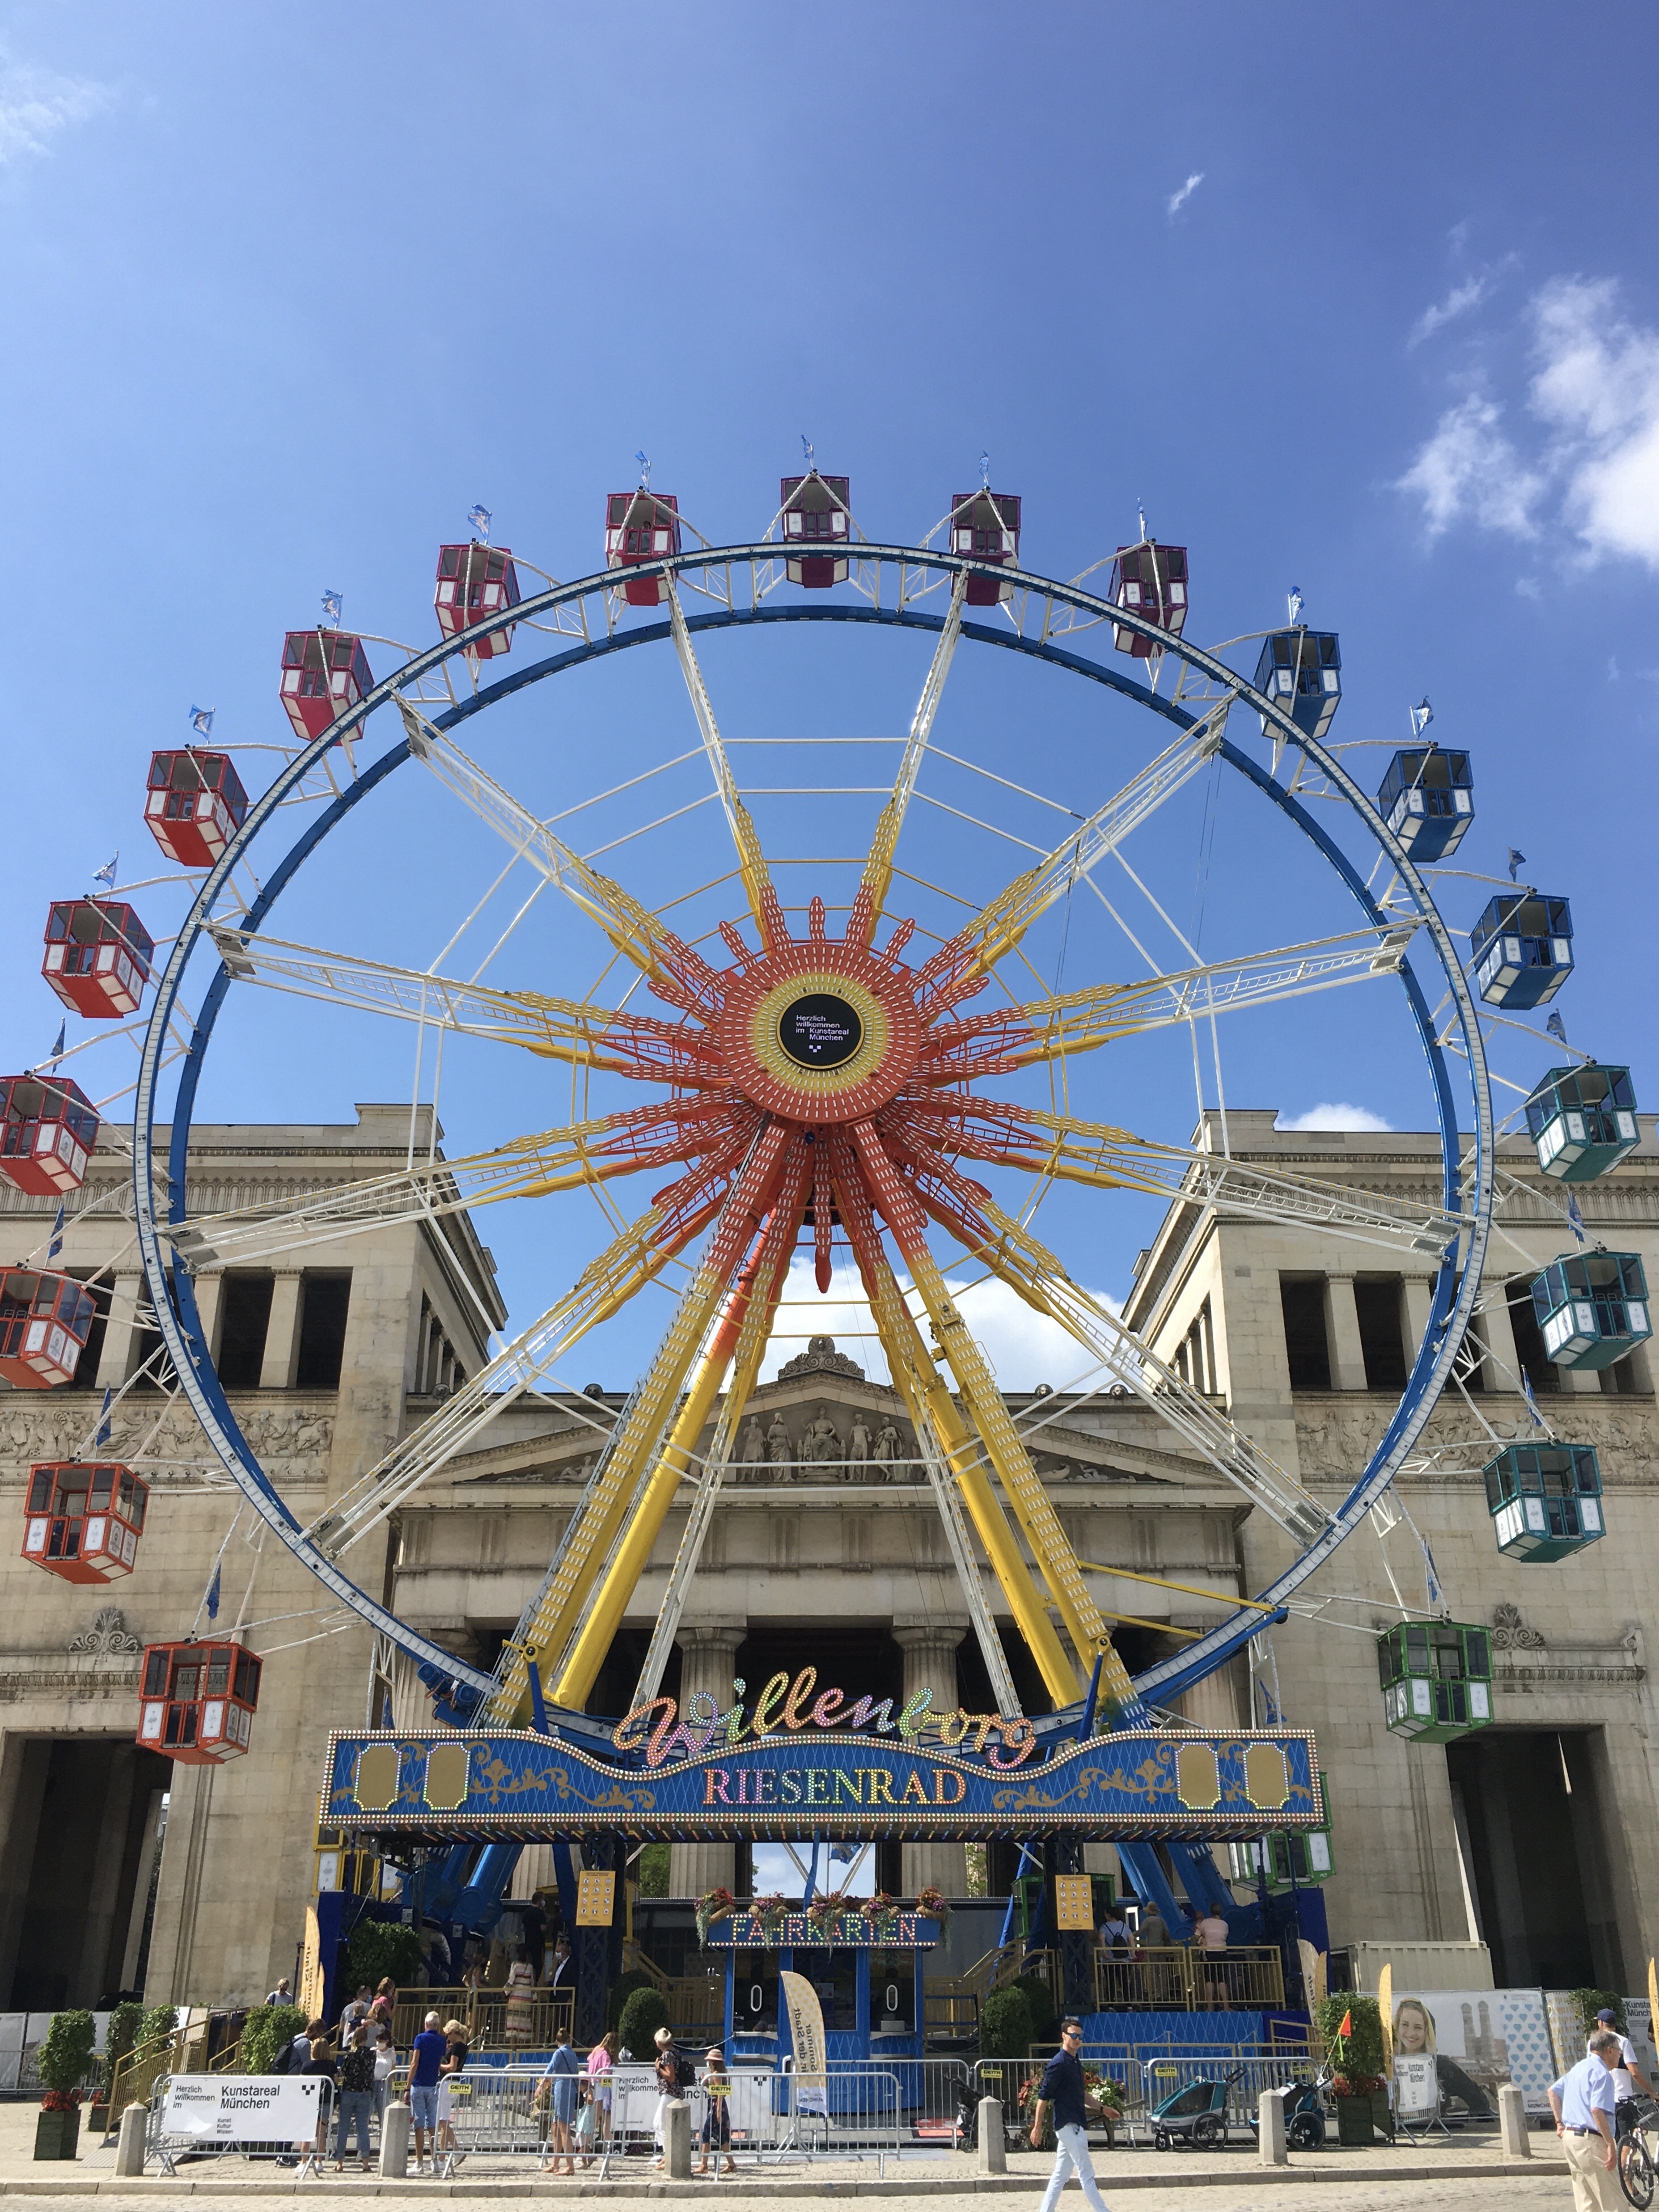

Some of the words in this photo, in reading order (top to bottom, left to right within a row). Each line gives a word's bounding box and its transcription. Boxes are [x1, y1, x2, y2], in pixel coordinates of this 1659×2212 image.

[612, 1665, 1037, 1770] Willenborg
[702, 1769, 967, 1804] RIESENRAD
[733, 1919, 916, 1940] FAHRKARTEN
[221, 2084, 281, 2096] Kunstareal
[220, 2097, 270, 2109] München
